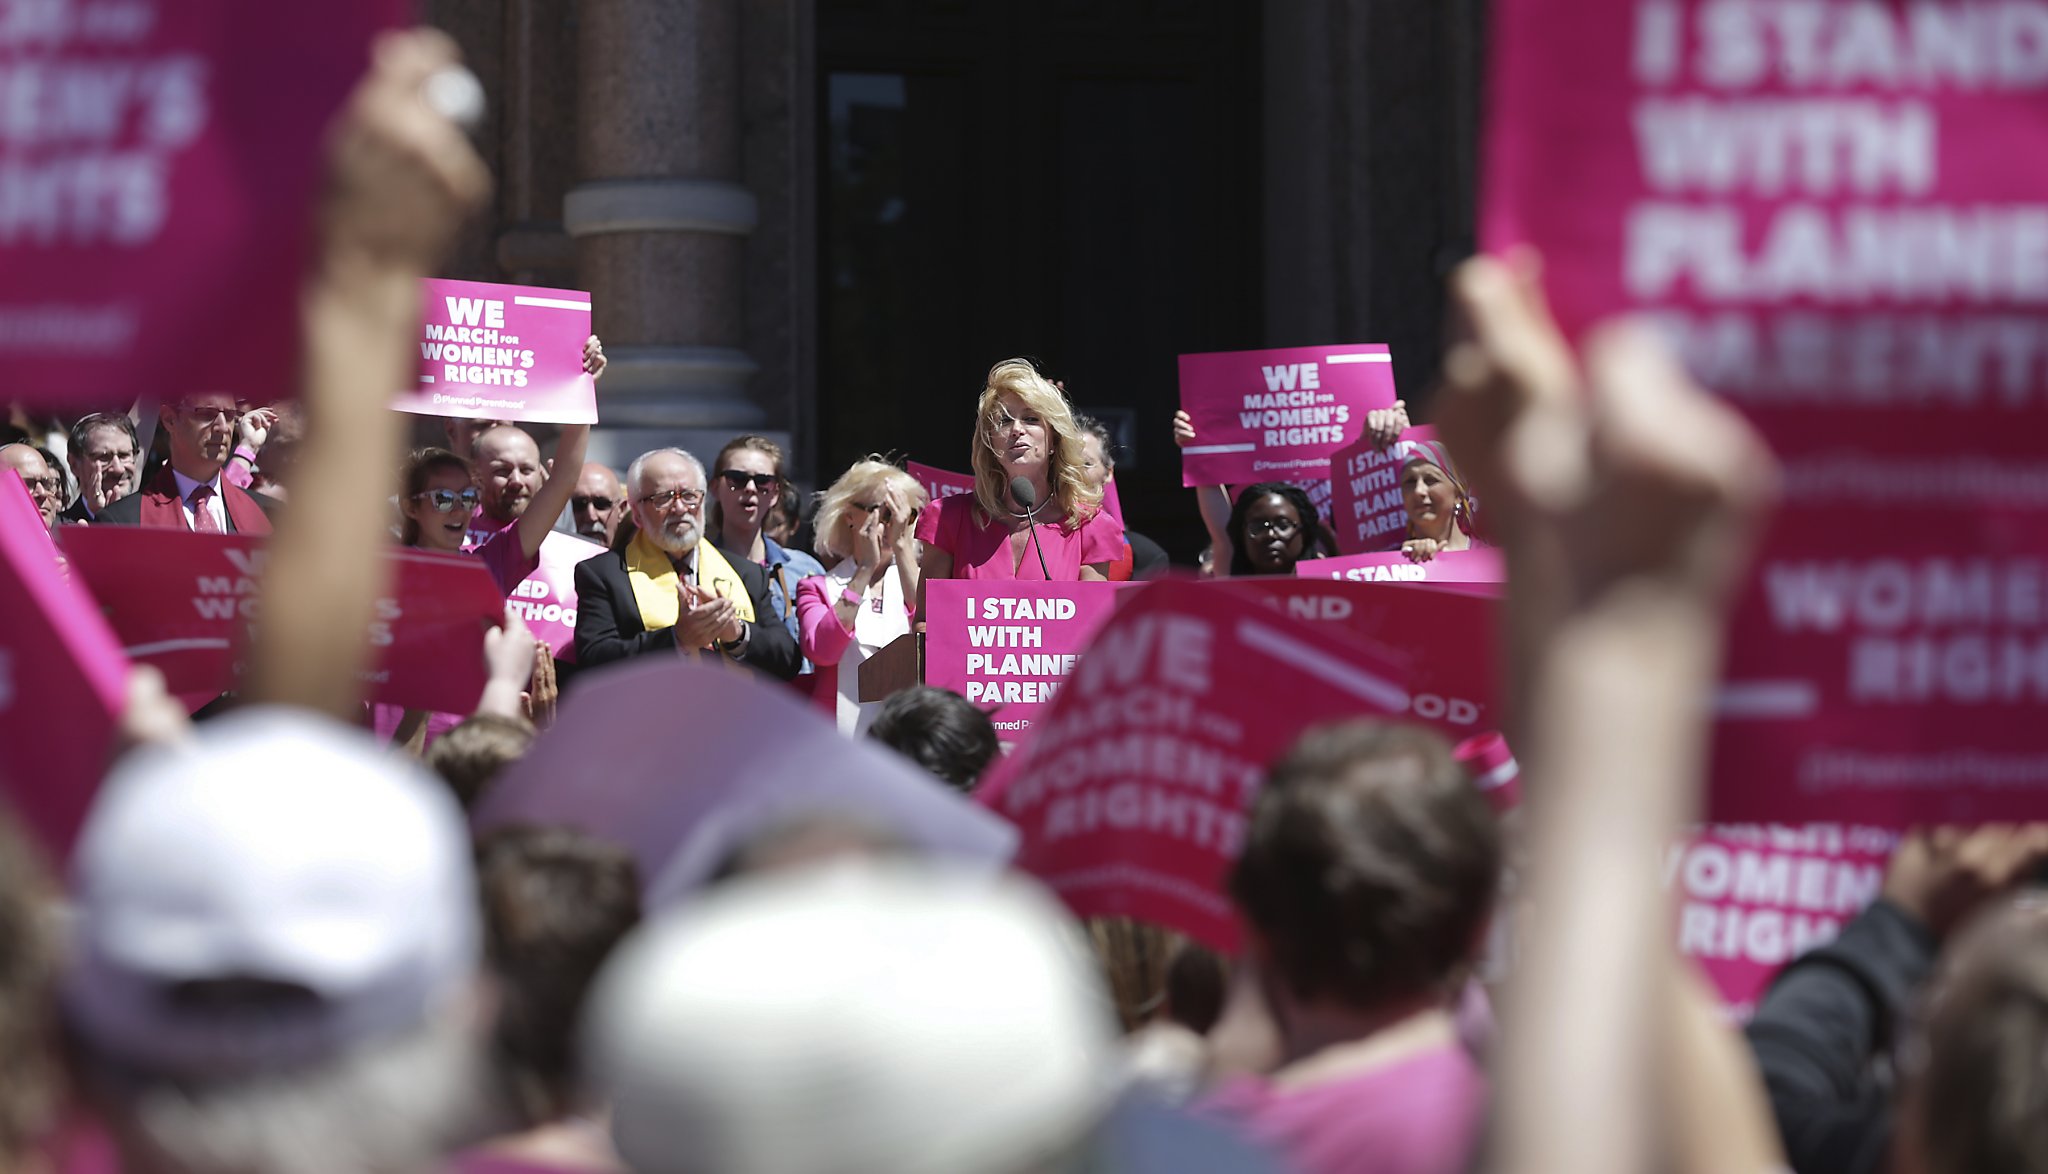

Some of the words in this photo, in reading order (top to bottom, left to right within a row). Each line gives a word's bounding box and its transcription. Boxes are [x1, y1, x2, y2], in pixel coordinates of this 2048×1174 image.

[446, 296, 505, 329] WE
[425, 324, 499, 345] MARCH
[500, 335, 520, 345] FOR
[420, 342, 535, 369] WOMEN'S
[444, 364, 528, 387] RIGHTS
[1261, 363, 1320, 392] WE
[442, 395, 476, 406] Planned
[1243, 390, 1316, 409] MARCH
[1239, 405, 1350, 429] WOMEN'S
[1264, 425, 1344, 447] RIGHTS
[1348, 458, 1355, 476] I
[931, 481, 938, 499] I
[1351, 467, 1397, 497] WITH
[1346, 564, 1427, 582] STAND
[966, 597, 976, 619] I
[983, 597, 1076, 620] STAND
[967, 626, 1043, 648] WITH
[966, 654, 1082, 676] PLANNE
[966, 681, 1057, 703] PAREN
